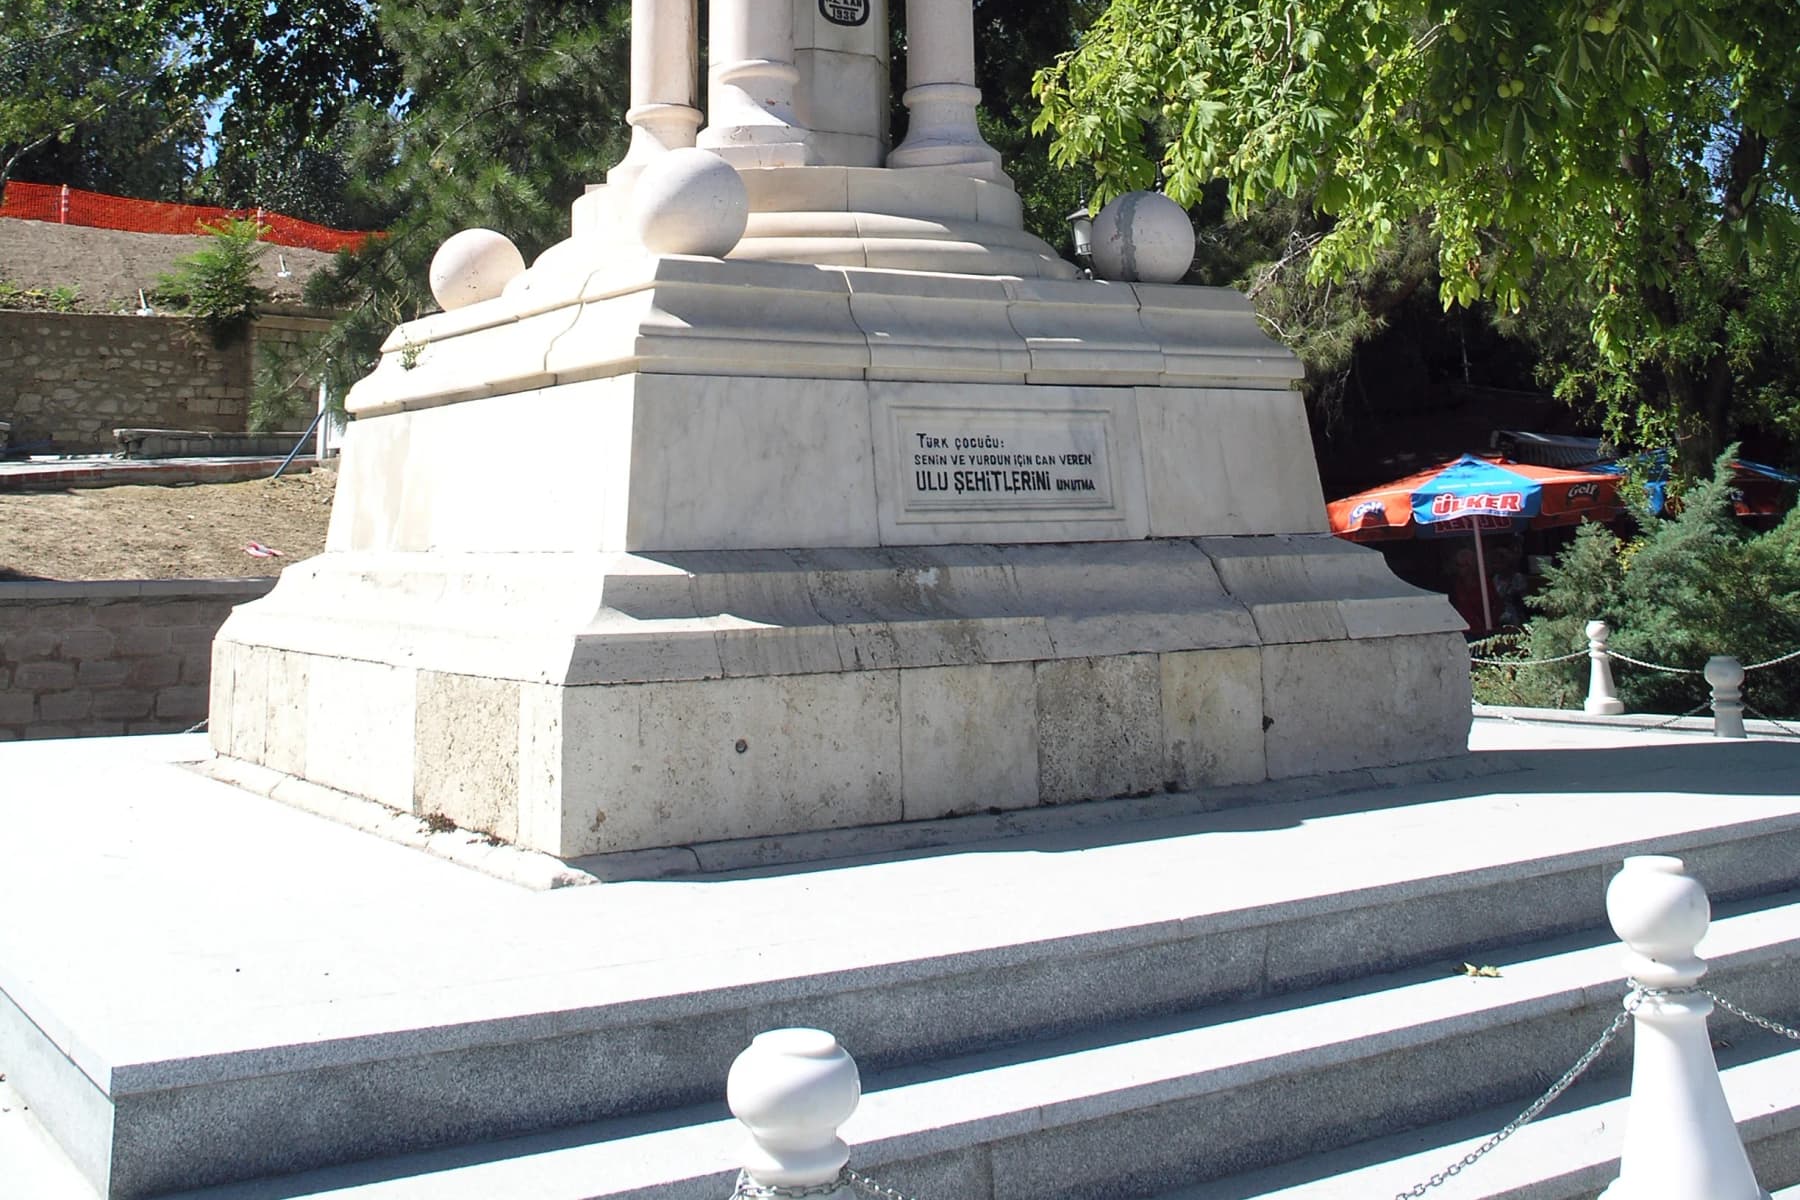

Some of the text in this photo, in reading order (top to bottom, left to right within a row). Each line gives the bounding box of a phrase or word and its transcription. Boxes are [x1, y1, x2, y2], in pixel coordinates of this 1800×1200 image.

[914, 453, 1092, 468] SENİN VE YURDUN İÇİN CAN VEREN
[916, 471, 948, 491] ULU
[1056, 479, 1096, 491] UNUTMA
[1568, 483, 1598, 498] Golf
[1432, 492, 1521, 516] ÜLKER
